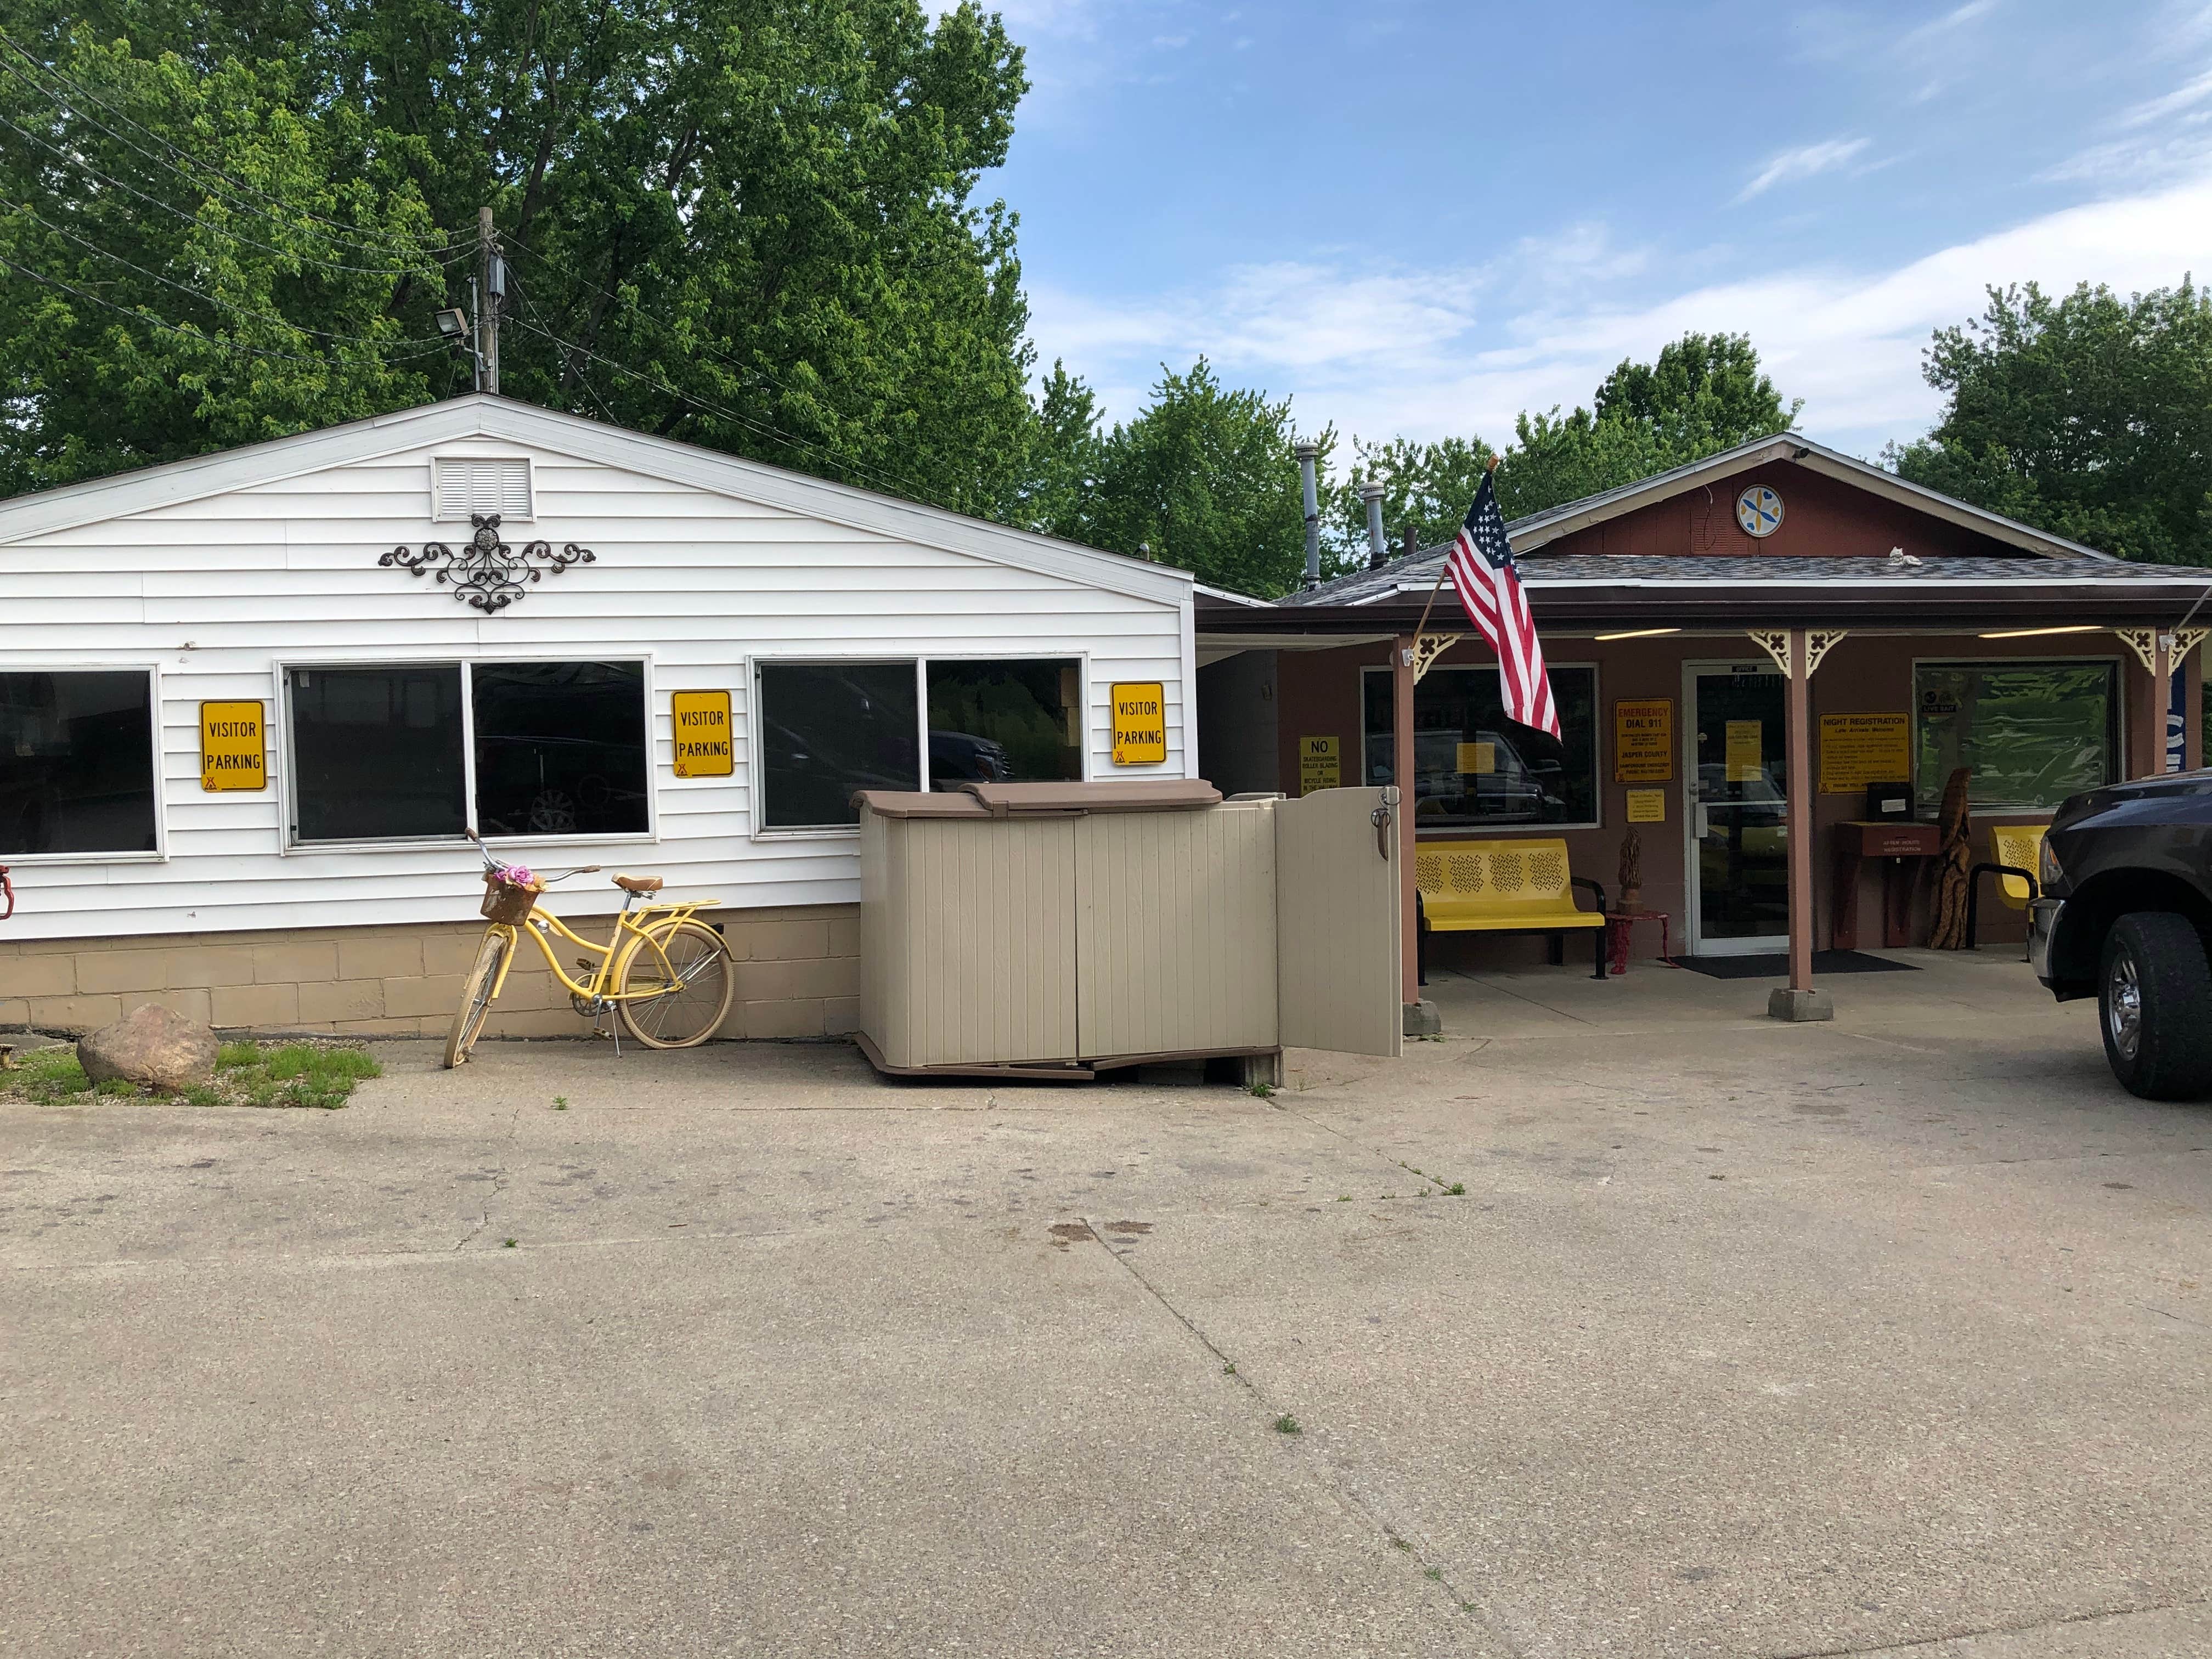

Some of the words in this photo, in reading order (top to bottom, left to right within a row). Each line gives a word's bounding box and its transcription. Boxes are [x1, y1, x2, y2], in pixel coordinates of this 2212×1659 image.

[1119, 701, 1158, 715] VISITOR
[1618, 707, 1669, 718] EMERGENCY
[680, 711, 724, 726] VISITOR
[1626, 719, 1645, 728] DIAL
[1648, 719, 1661, 727] 911
[209, 721, 256, 737] VISITOR
[1117, 730, 1161, 744] PARKING
[679, 741, 728, 757] PARKING
[1311, 741, 1328, 753] NO
[207, 754, 260, 770] PARKING
